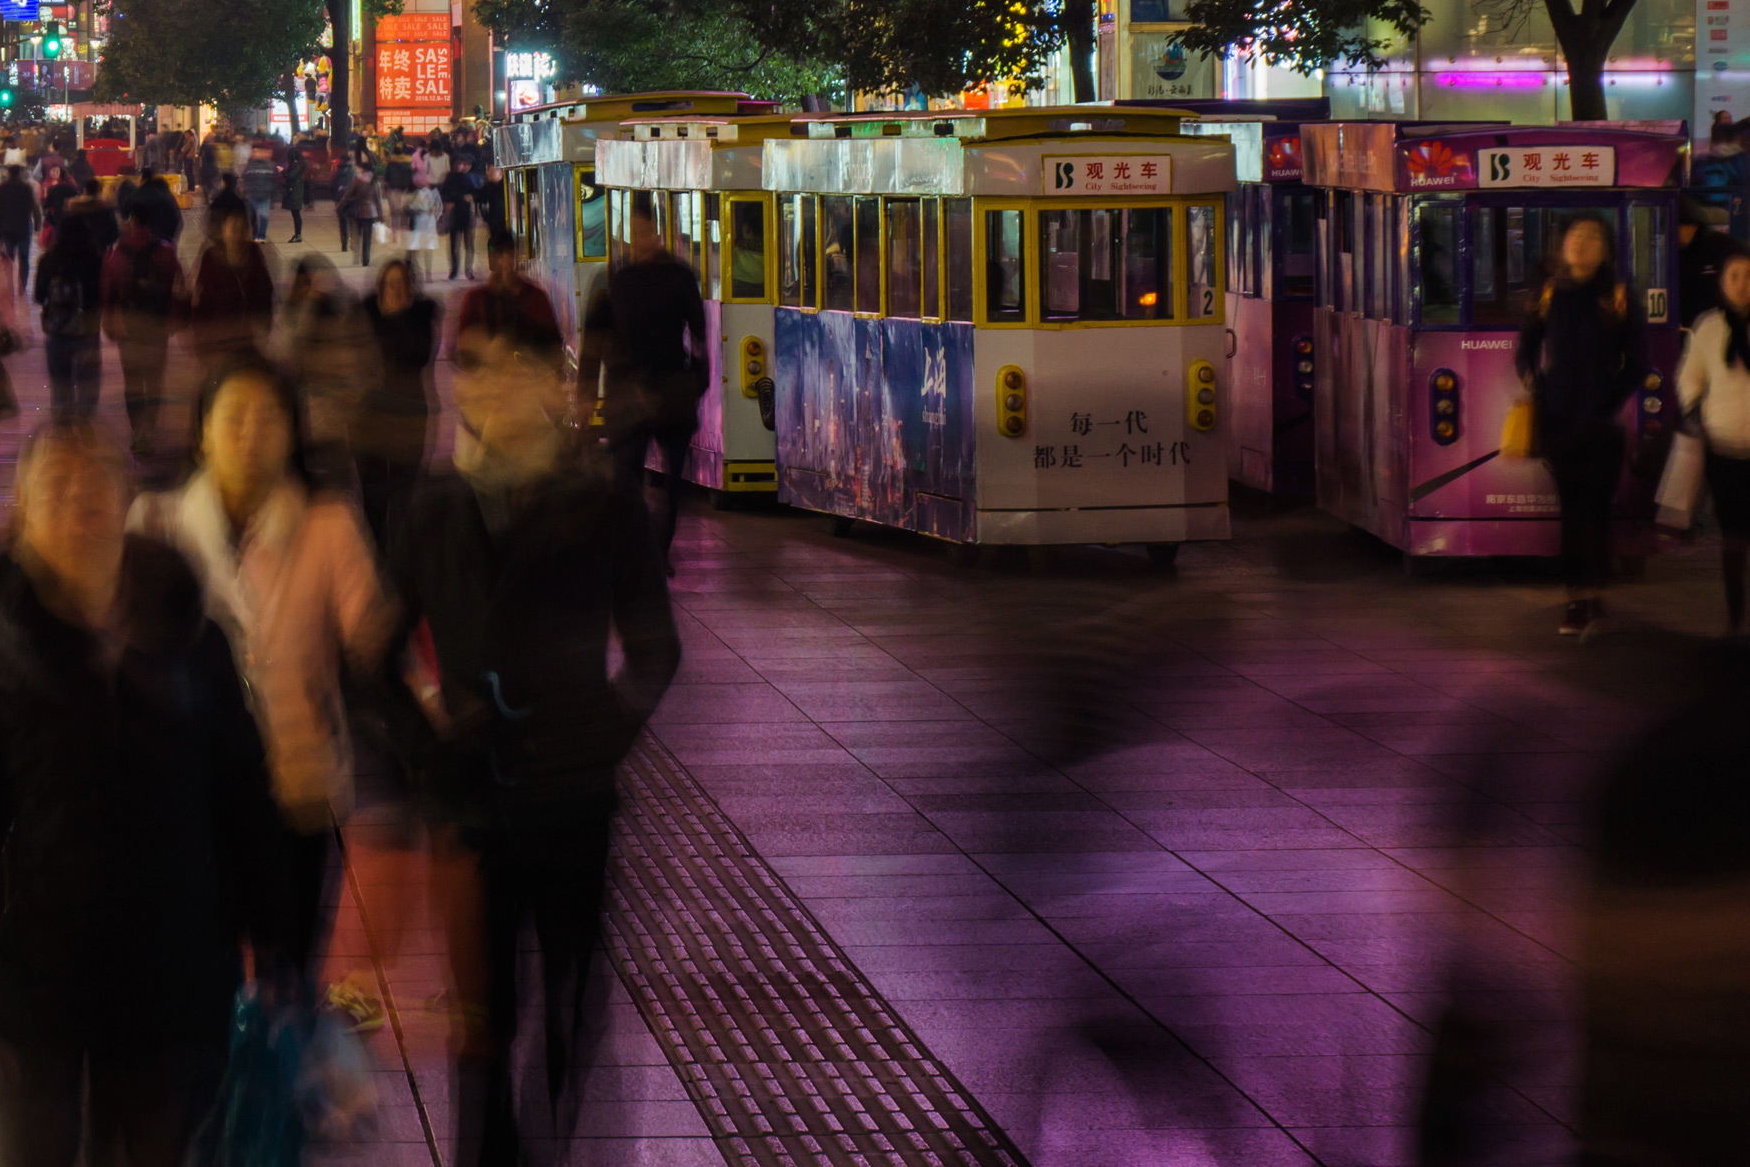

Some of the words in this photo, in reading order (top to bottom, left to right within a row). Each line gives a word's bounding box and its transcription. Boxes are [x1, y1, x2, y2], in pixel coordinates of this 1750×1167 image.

[427, 22, 448, 30] SALE
[379, 49, 411, 72] 年终
[415, 48, 437, 63] SA
[437, 48, 448, 78] SALE
[417, 64, 436, 79] LE
[379, 76, 412, 100] 特卖
[1086, 161, 1158, 180] 观光车
[1522, 152, 1601, 172] 观光车
[1085, 182, 1102, 192] City
[1110, 182, 1158, 192] Sightseeing
[1410, 176, 1455, 188] HUAWEI
[1522, 174, 1541, 183] City
[1549, 174, 1600, 183] Sightseeing
[1203, 290, 1214, 316] 2
[1649, 291, 1667, 319] 10
[1461, 339, 1513, 350] HUAWEI
[921, 346, 947, 399] 上海
[1069, 410, 1149, 436] 每一代
[1034, 441, 1191, 470] 都是一个时代
